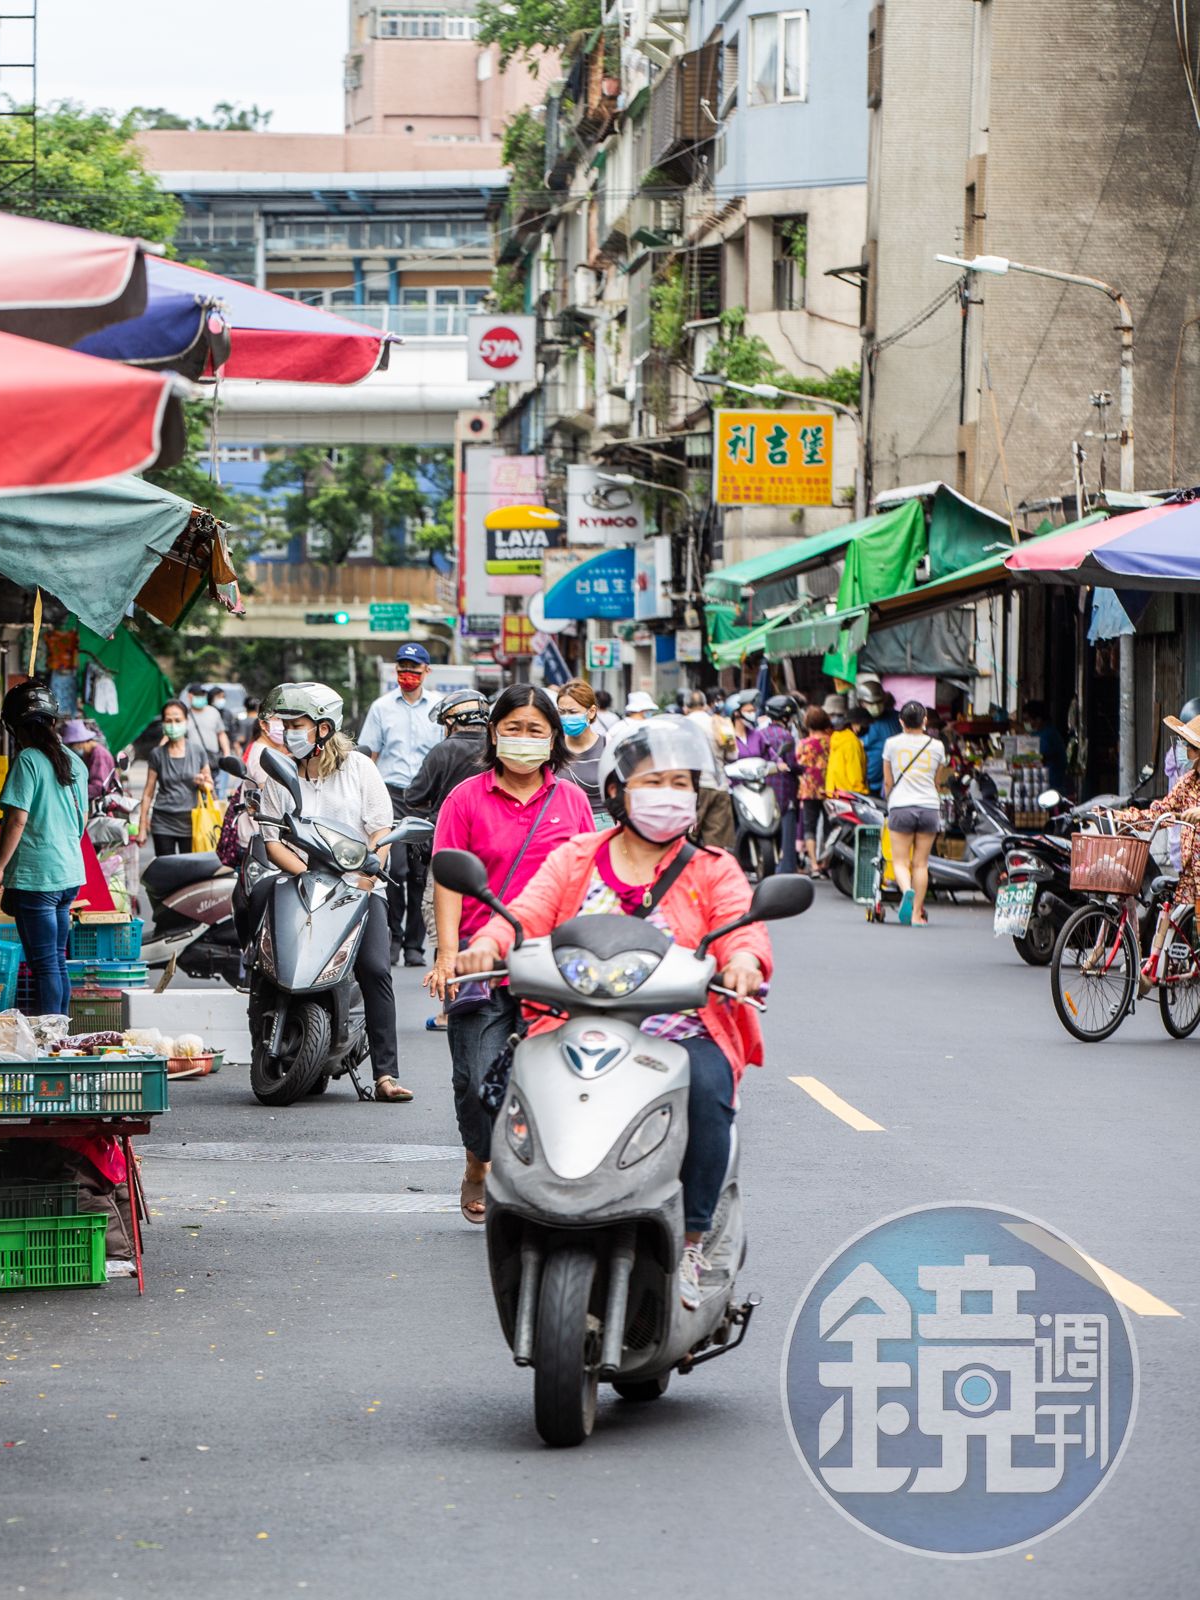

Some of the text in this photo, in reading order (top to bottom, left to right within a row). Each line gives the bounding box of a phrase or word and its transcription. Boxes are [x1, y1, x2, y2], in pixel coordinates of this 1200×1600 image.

[479, 339, 522, 362] SYM
[726, 424, 825, 465] 利吉堡
[578, 516, 638, 529] KYMCO
[494, 529, 550, 548] LAYA
[495, 547, 544, 559] BURGE
